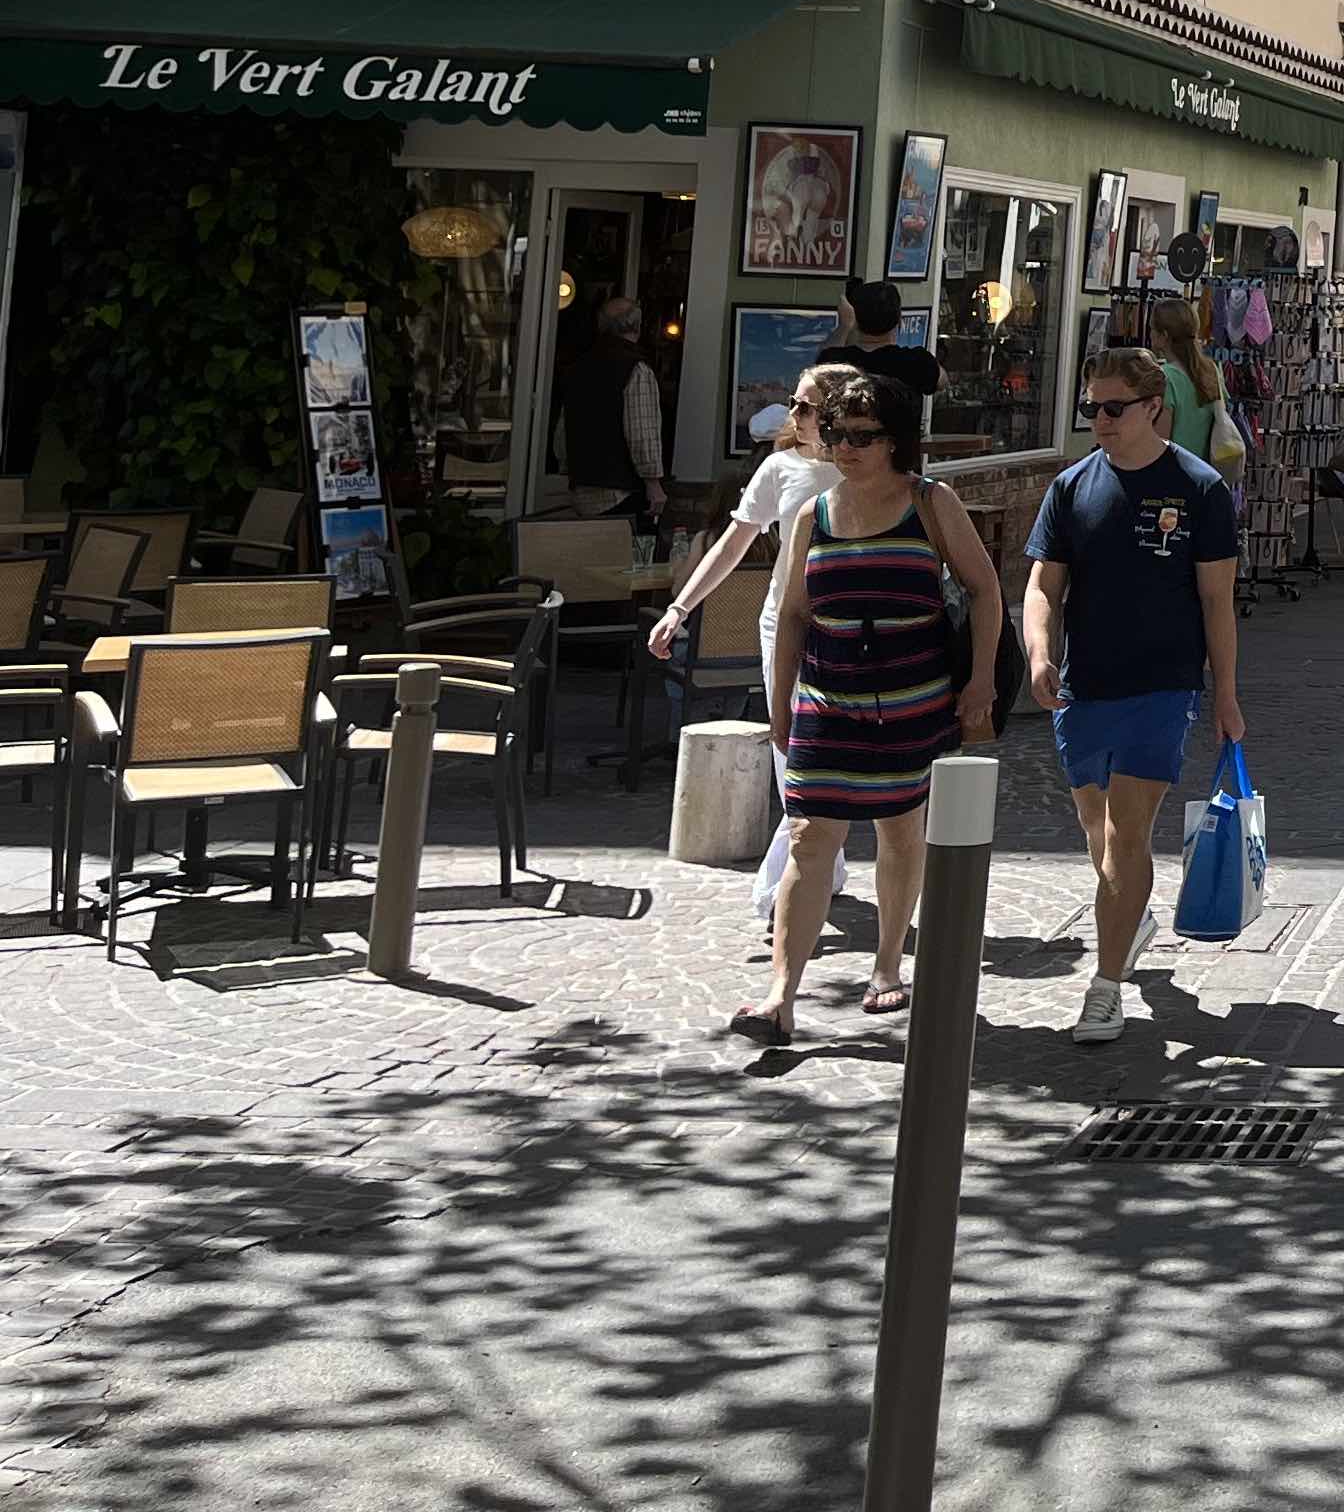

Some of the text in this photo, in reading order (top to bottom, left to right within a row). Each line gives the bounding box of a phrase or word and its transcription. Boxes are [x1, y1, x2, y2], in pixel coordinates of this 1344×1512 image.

[98, 44, 537, 115] Le Vert Galant
[1171, 78, 1240, 131] Le Vert Galant
[753, 238, 842, 266] FANNY
[900, 316, 921, 334] NICE
[324, 477, 376, 489] MONACO
